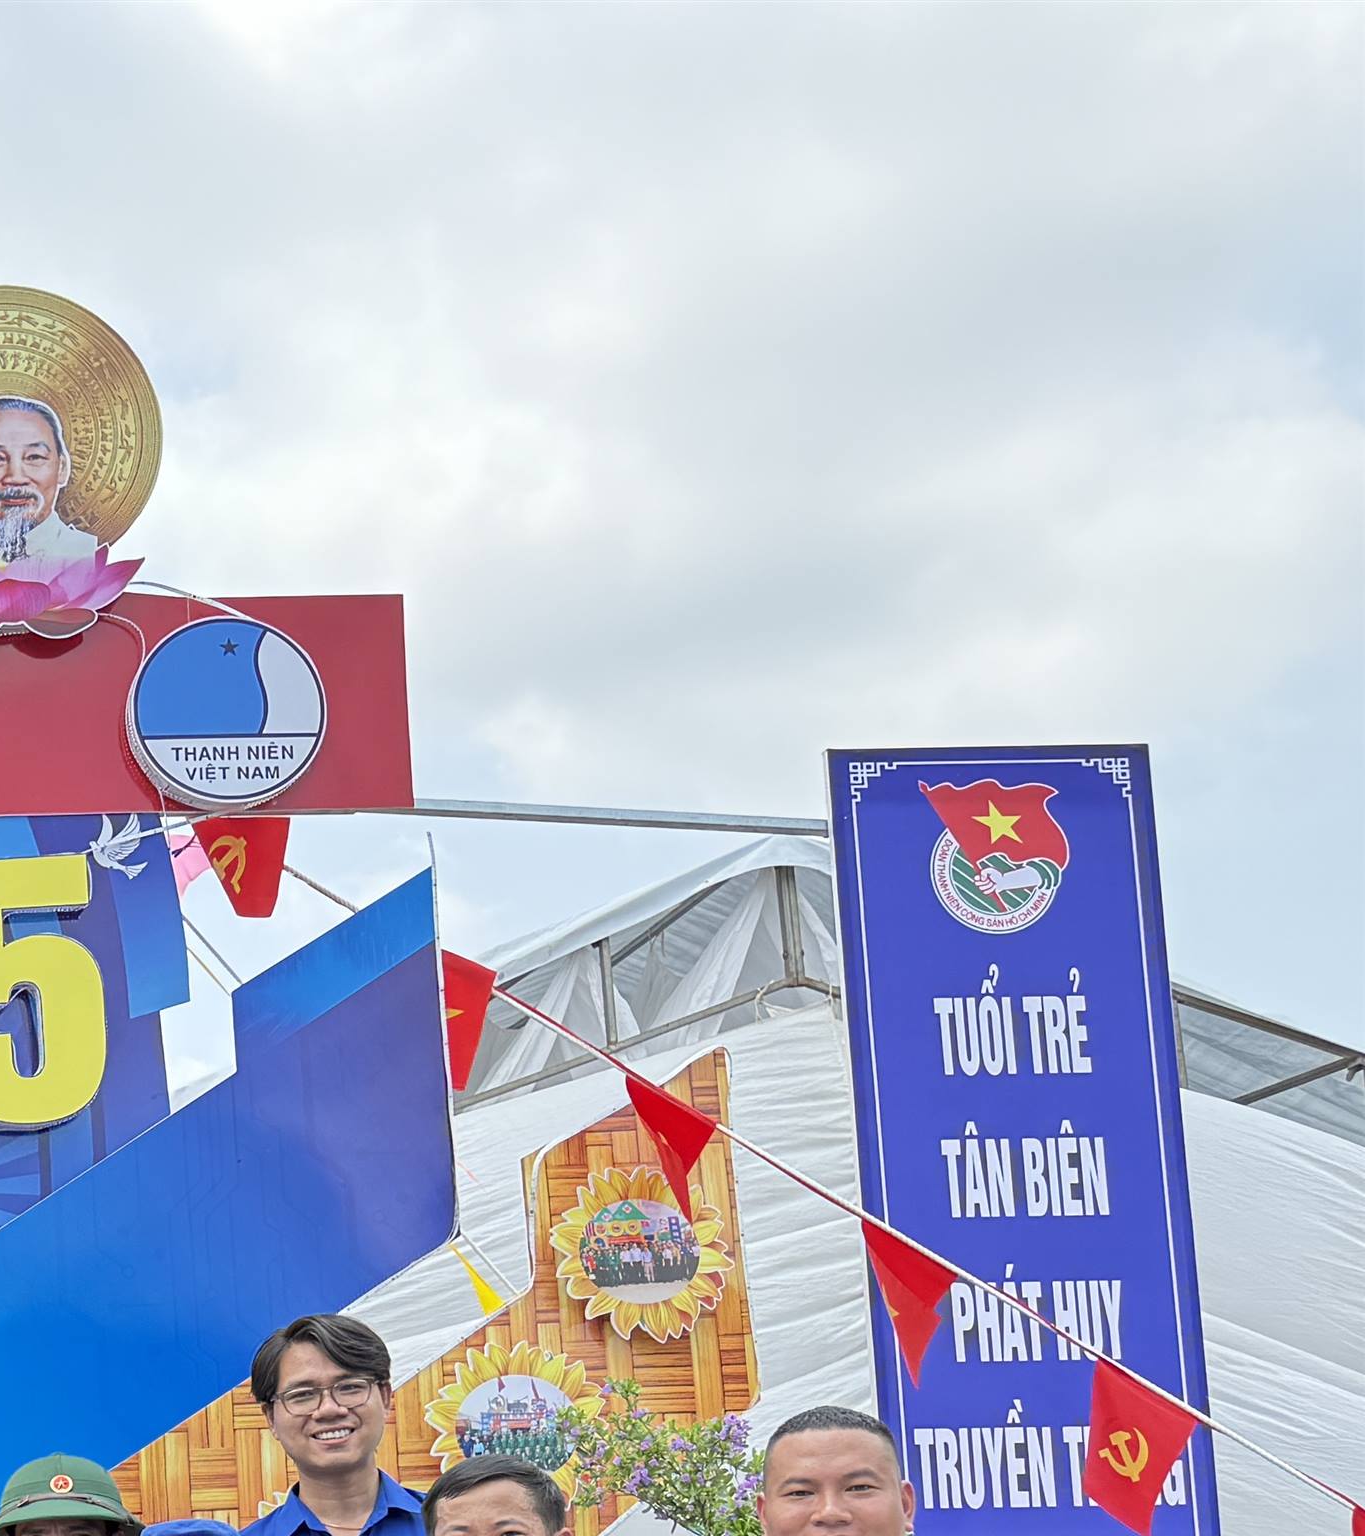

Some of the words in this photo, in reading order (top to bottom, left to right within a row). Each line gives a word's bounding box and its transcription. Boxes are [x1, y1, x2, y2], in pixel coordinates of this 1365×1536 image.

[171, 745, 239, 762] THANH
[247, 741, 294, 760] NIÊN
[185, 763, 230, 783] VIỆT
[237, 766, 280, 780] NAM
[933, 963, 1018, 1076] TUỔI
[1022, 967, 1093, 1075] TRẺ
[940, 1120, 1015, 1220] TÂN
[1021, 1120, 1111, 1217] BIÊN
[950, 1262, 1045, 1363] PHÁT
[1051, 1279, 1123, 1362] HUY
[913, 1399, 1057, 1510] TRUYỀN
